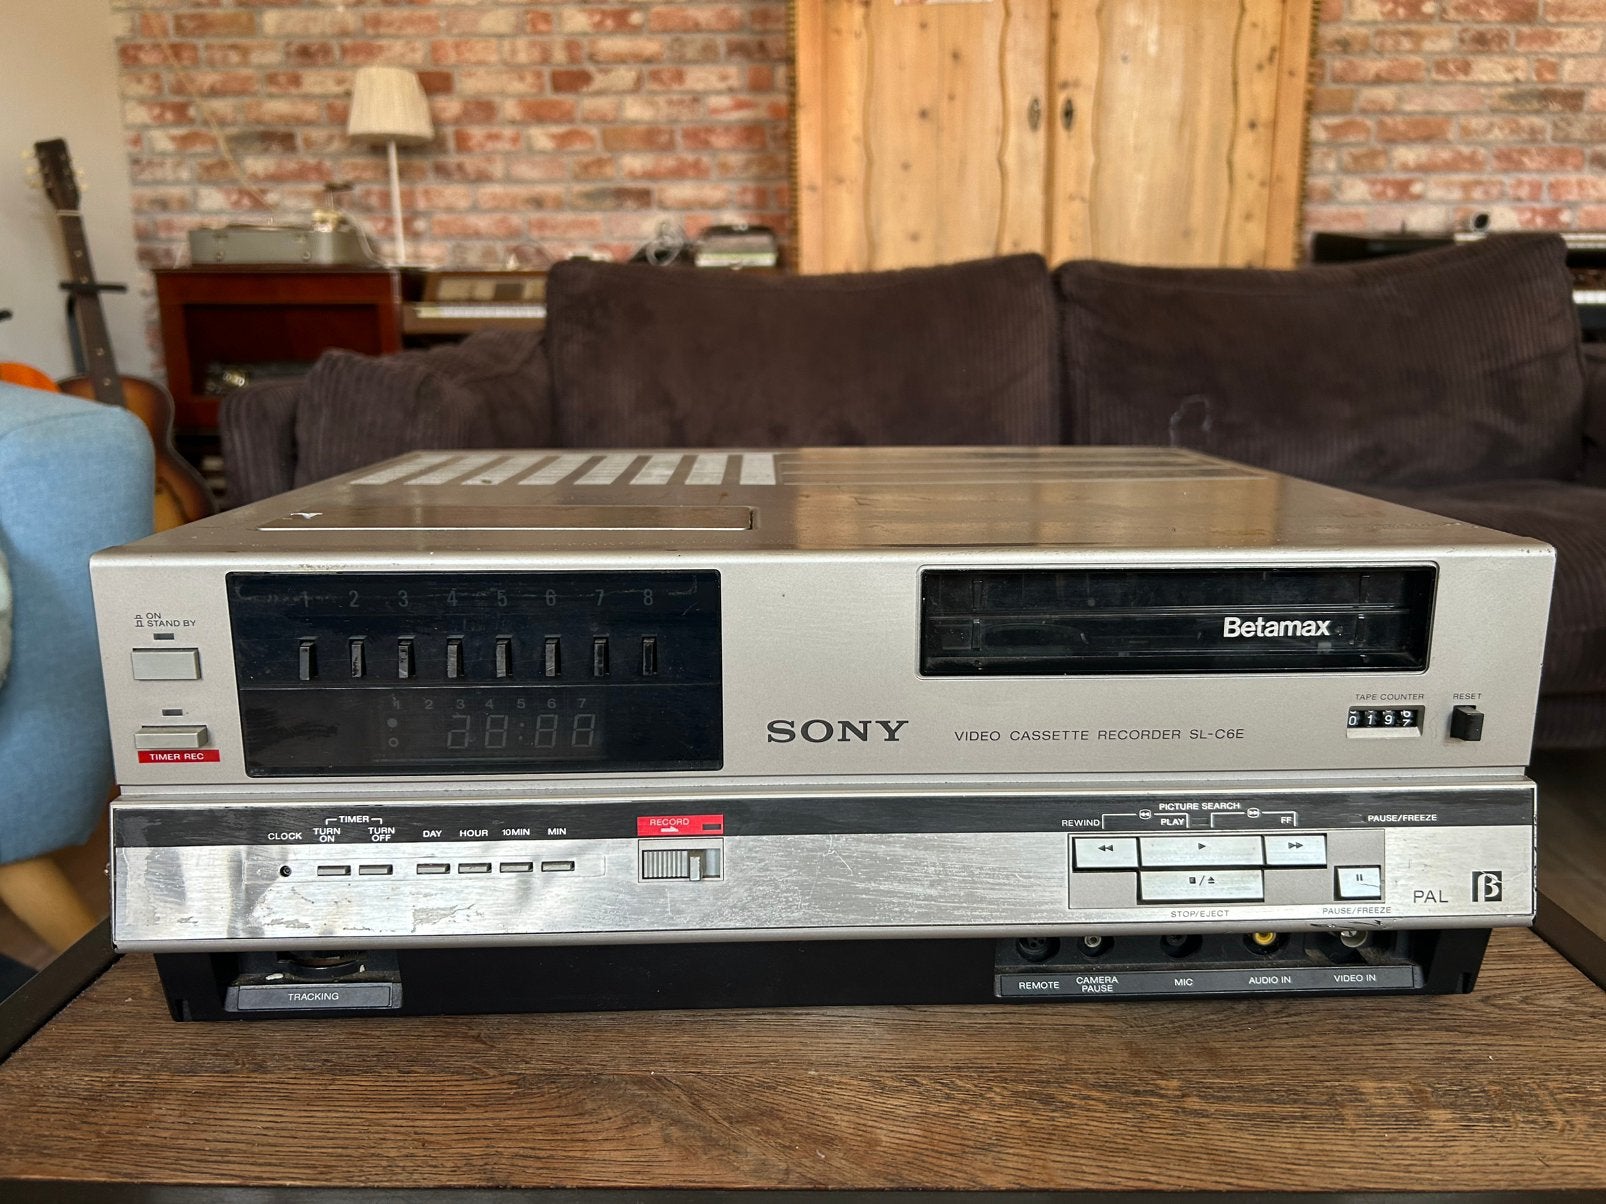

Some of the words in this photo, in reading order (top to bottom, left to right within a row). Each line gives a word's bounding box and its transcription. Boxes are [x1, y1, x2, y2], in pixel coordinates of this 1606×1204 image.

[349, 590, 360, 608] 2
[398, 590, 409, 607] 3
[447, 589, 458, 607] 4
[497, 590, 508, 607] 5
[546, 589, 556, 606] 6
[596, 589, 605, 606] 7
[643, 588, 654, 606] 8
[147, 619, 181, 627] STAND
[183, 619, 196, 627] BY
[1223, 616, 1331, 638] Betamax
[1355, 693, 1378, 701] TAPE
[1380, 693, 1425, 701] COUNTER
[425, 700, 434, 710] 2
[456, 700, 465, 709] 3
[485, 699, 495, 709] 4
[517, 699, 526, 709] 5
[547, 699, 557, 708] 6
[576, 698, 587, 708] 7
[766, 719, 909, 743] SONY
[954, 730, 1001, 742] VIDEO
[1009, 730, 1090, 741] CASSETTE
[1097, 729, 1181, 740] RECORDER
[1189, 728, 1245, 740] SL-C6E
[149, 753, 182, 762] TIMER
[184, 753, 205, 761] REC
[1159, 802, 1199, 811] PICTURE
[1201, 801, 1240, 810] SEARCH
[338, 815, 369, 823] TIMER
[649, 818, 690, 826] RECORD
[1160, 817, 1185, 826] PLAY
[1280, 816, 1292, 824] FF
[1367, 813, 1438, 823] PAUSE/FREEZE
[1061, 819, 1100, 827] REWIND
[313, 827, 341, 836] TURN
[367, 826, 395, 835] TURN
[422, 829, 443, 838] DAY
[459, 828, 489, 837] HOUR
[501, 827, 531, 837] 10MIN
[547, 827, 567, 836] MIN
[267, 831, 302, 840] CLOCK
[319, 834, 335, 843] ON
[371, 833, 391, 842] OFF
[1413, 889, 1449, 903] PAL
[1170, 909, 1230, 919] STOP/EJECT
[1322, 906, 1392, 915] PAUSE/FREEZE
[1075, 976, 1119, 985] CAMERA
[1174, 977, 1194, 987] MIC
[1248, 976, 1278, 985] AUDIO
[1280, 975, 1291, 984] IN
[1333, 974, 1363, 984] VIDEO
[1364, 974, 1376, 983] IN
[1018, 981, 1060, 991] REMOTE
[1081, 984, 1114, 994] PAUSE
[288, 992, 339, 1001] TRACKING
